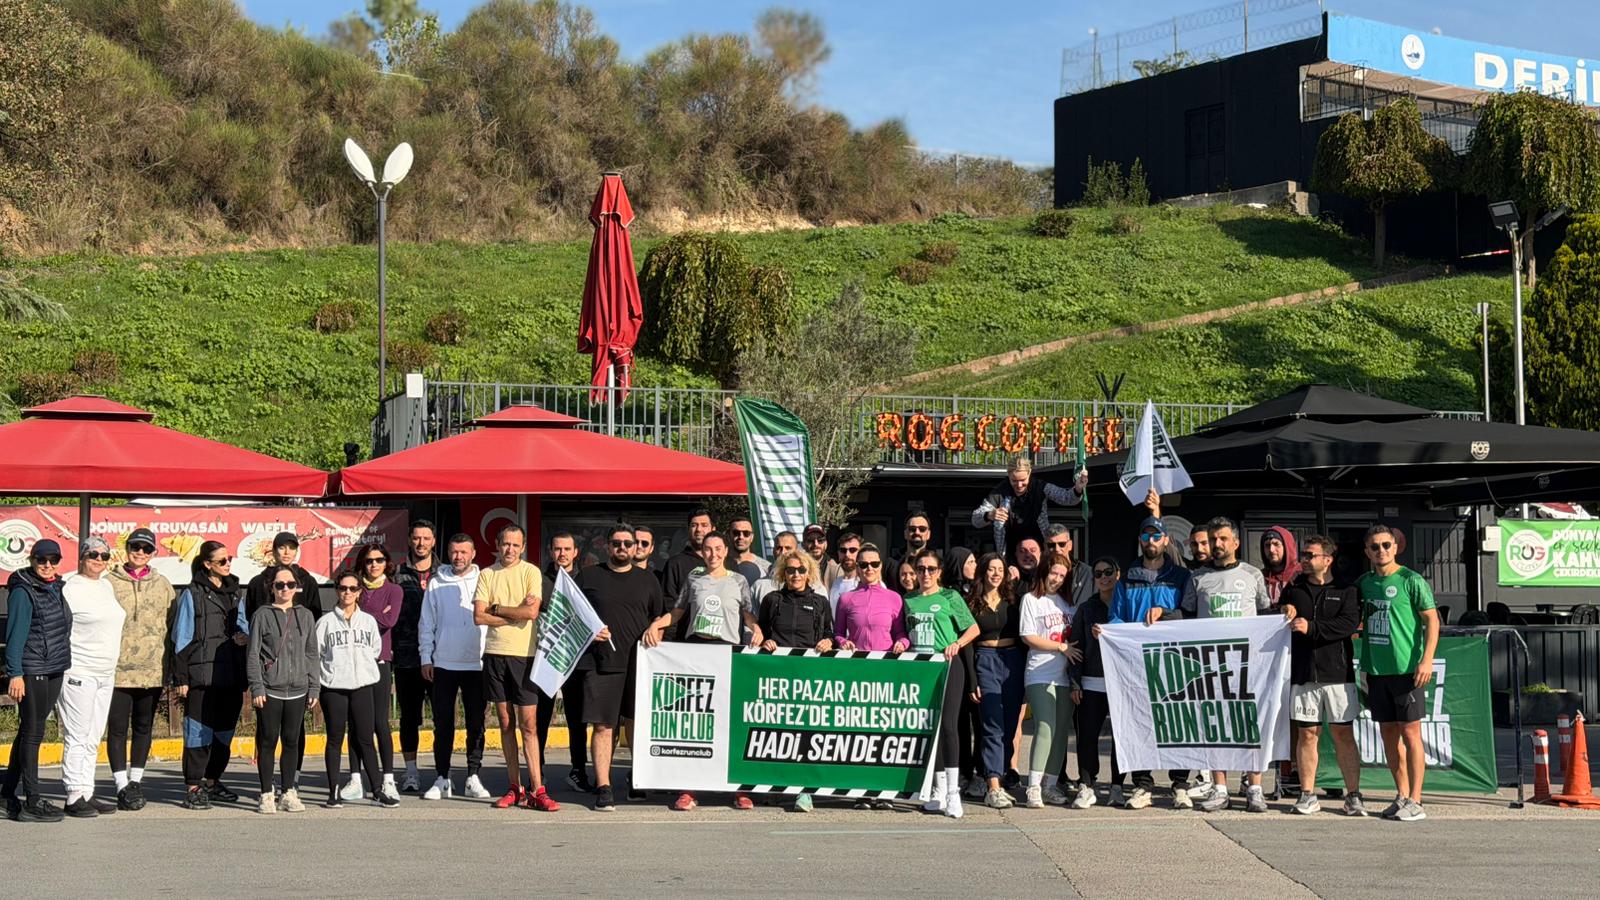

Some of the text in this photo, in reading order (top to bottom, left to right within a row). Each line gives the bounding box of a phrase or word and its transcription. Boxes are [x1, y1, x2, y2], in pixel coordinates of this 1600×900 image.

[876, 412, 1123, 453] ROG COFFEE
[89, 521, 137, 534] DONUT
[149, 521, 228, 534] KRUVASAN
[1142, 641, 1256, 703] KÖRFEZ
[652, 671, 716, 714] KÖRFEZ
[758, 677, 920, 705] HER PAZAR ADIMLAR
[650, 711, 715, 741] RUN CLUB
[743, 699, 831, 727] KÖRFEZ'DE
[1151, 701, 1262, 744] RUN CLUB
[661, 747, 712, 757] korfezrunclub
[747, 730, 928, 765] HADİ, SEN DE GEL!
